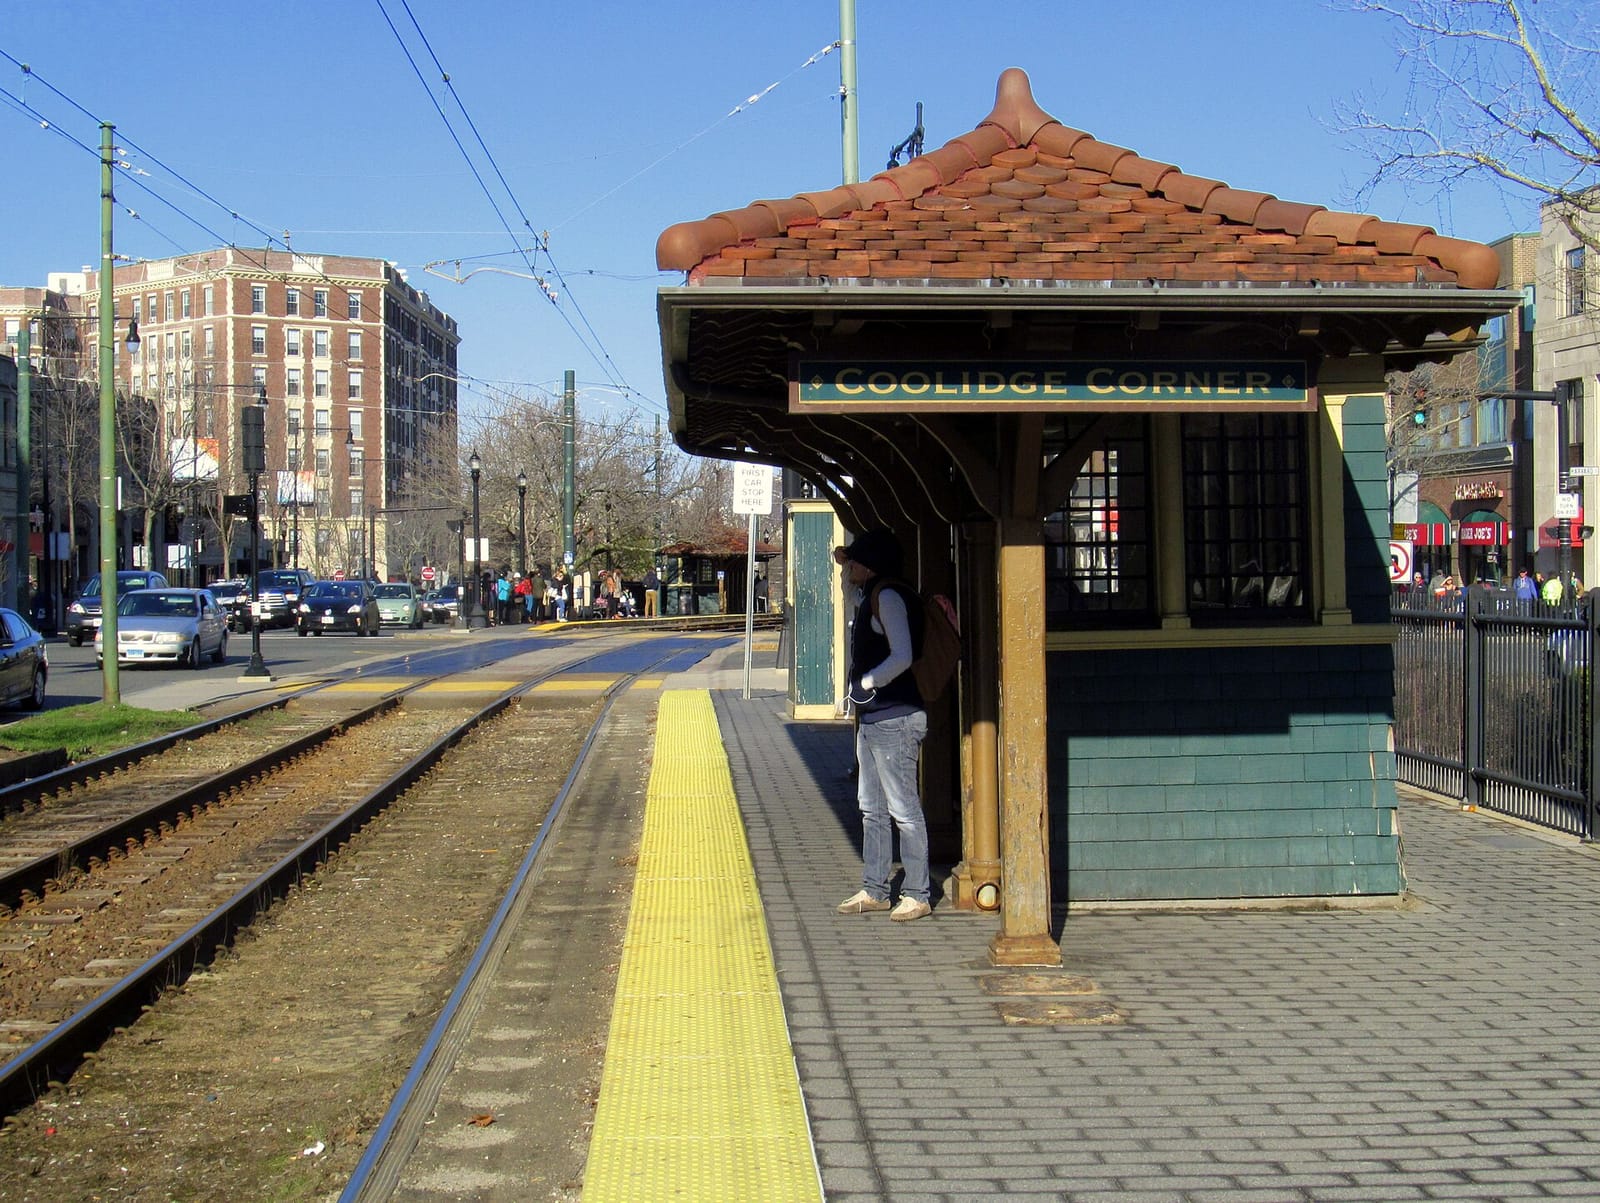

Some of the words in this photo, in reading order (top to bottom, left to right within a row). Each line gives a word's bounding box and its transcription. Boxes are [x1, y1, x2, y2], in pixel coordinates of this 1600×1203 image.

[835, 368, 1067, 394] COOLIDGE
[1085, 368, 1271, 394] CORNER
[1474, 526, 1492, 540] JOE'S
